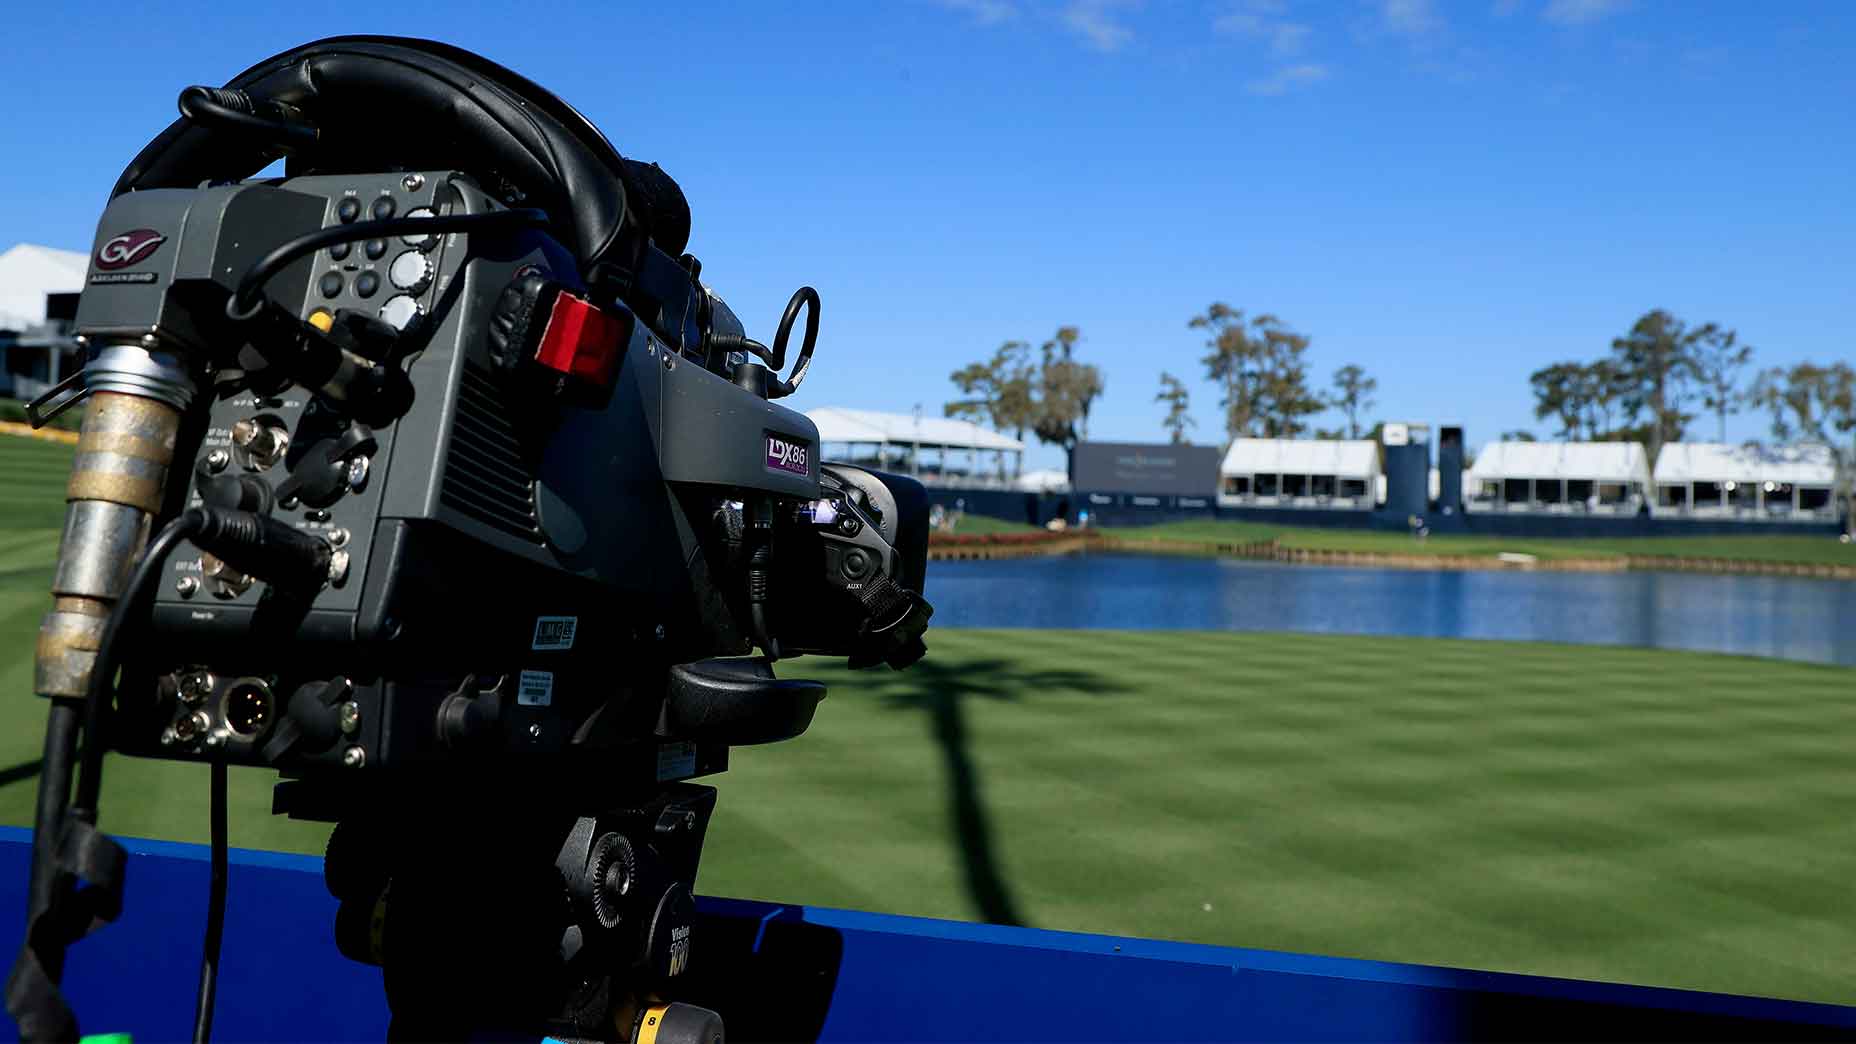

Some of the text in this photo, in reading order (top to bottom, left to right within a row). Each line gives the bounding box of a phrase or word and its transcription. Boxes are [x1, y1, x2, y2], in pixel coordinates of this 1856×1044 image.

[102, 236, 162, 263] GV
[768, 438, 805, 466] LDX86
[648, 1017, 656, 1026] 8
